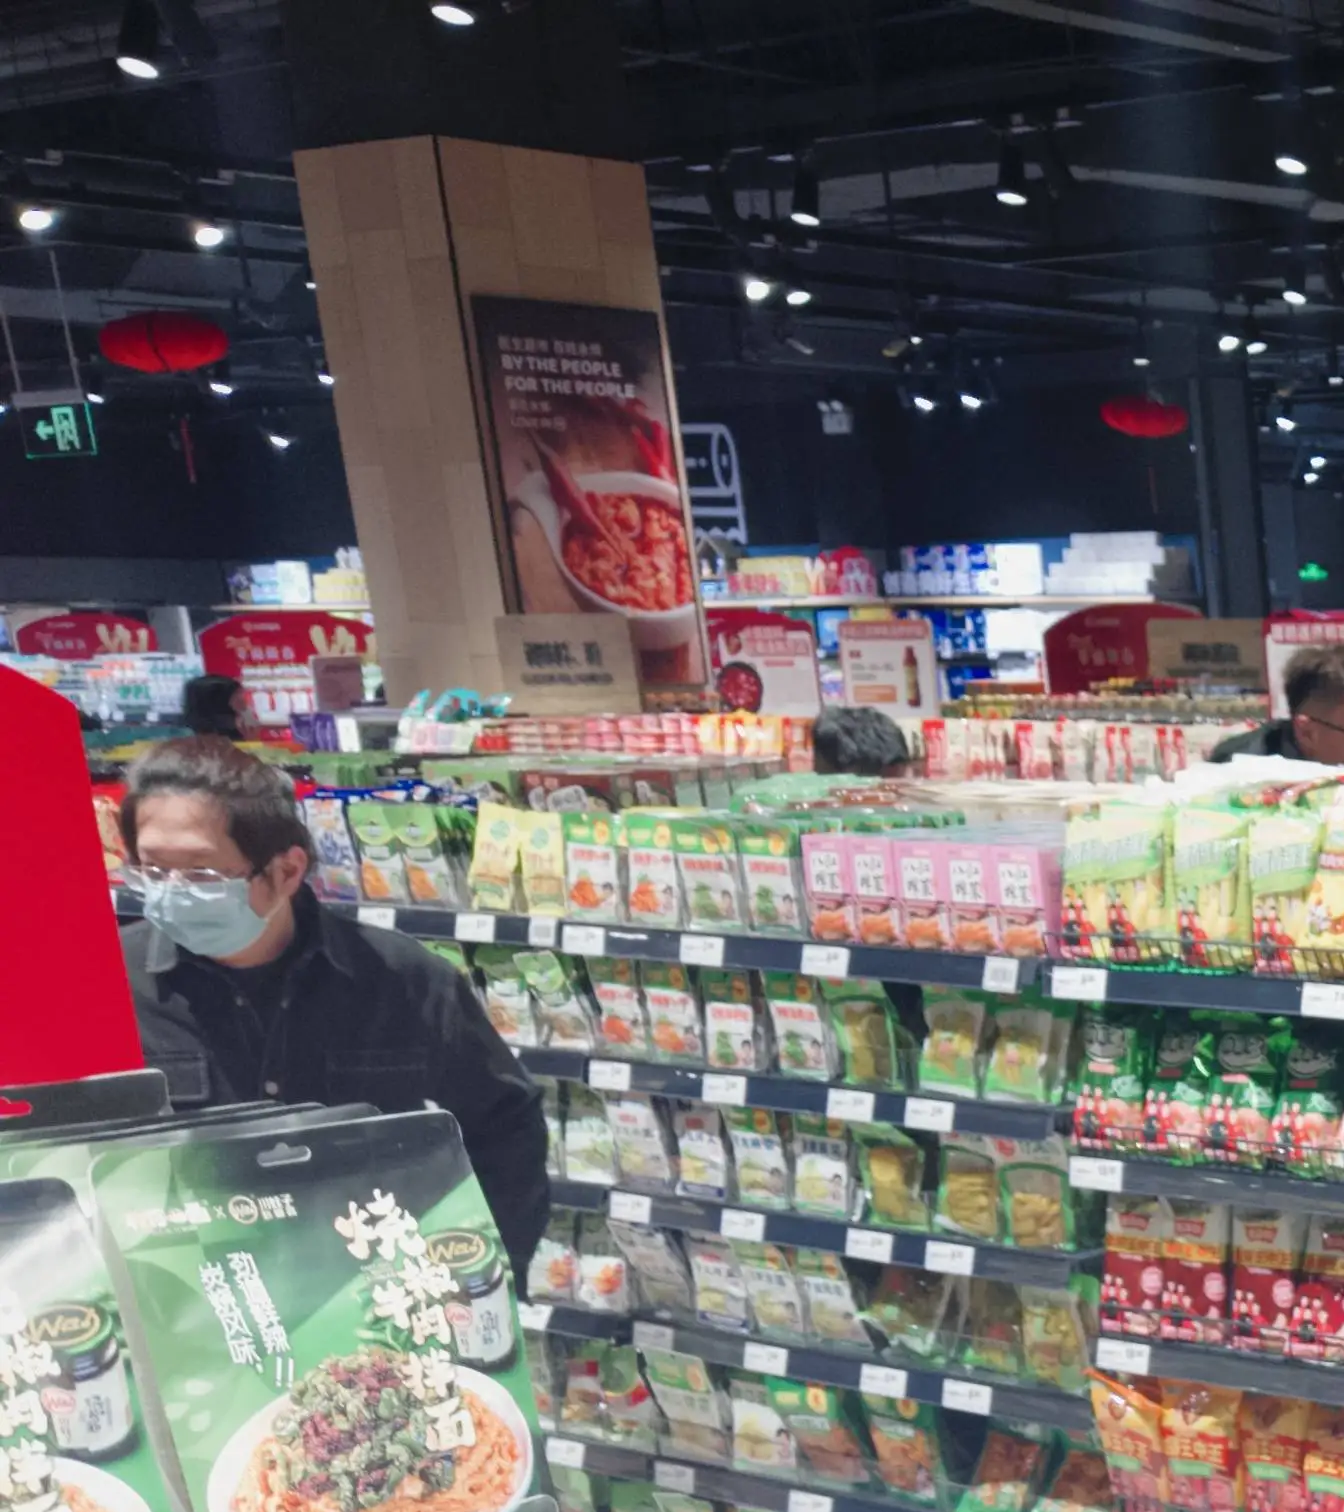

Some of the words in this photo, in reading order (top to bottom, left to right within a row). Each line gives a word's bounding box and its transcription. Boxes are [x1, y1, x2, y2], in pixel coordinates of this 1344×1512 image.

[502, 355, 522, 370] BY
[527, 356, 558, 373] THE
[561, 358, 622, 378] PEOPLE
[506, 377, 537, 391] FOR
[541, 379, 572, 395] THE
[576, 380, 635, 398] PEOPLE
